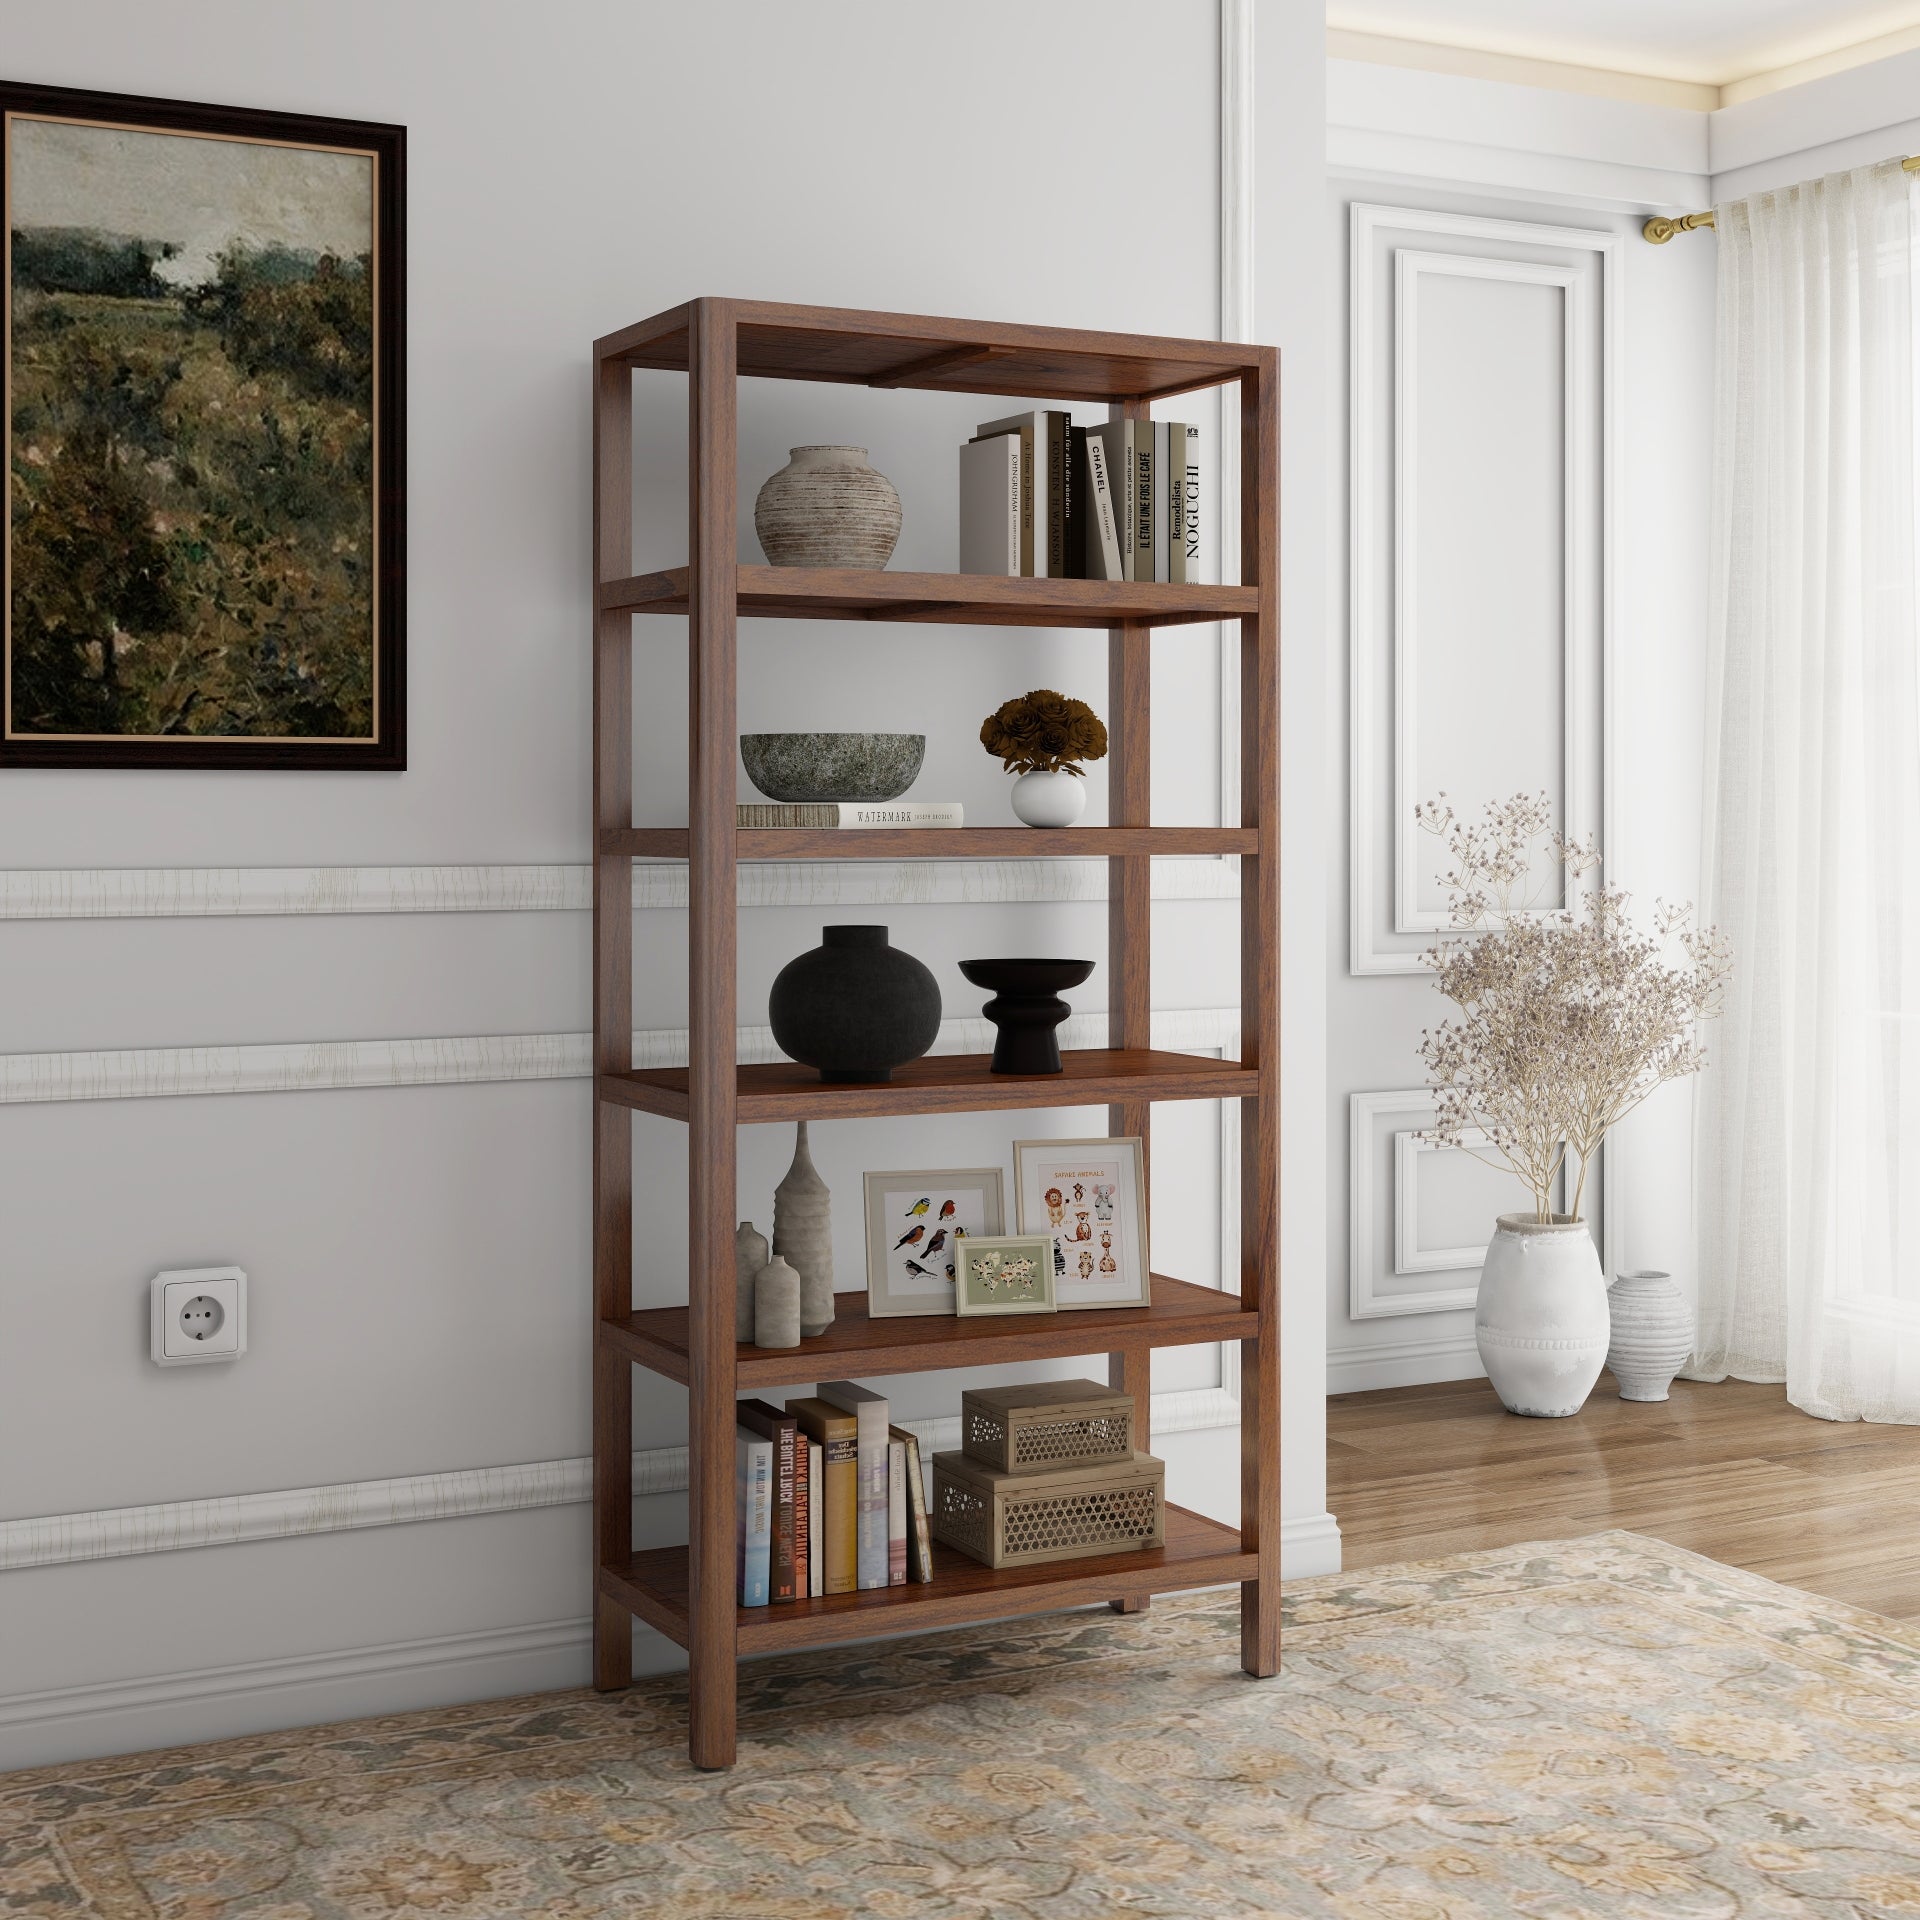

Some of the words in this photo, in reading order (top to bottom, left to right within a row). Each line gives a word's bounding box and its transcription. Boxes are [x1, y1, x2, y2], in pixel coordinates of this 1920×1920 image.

[1024, 441, 1032, 450] At
[1024, 453, 1032, 473] Home
[1052, 441, 1060, 491] KONSTEN
[1092, 446, 1105, 494] CHANEL
[1138, 452, 1151, 472] CAFÉ
[1140, 473, 1150, 482] LE
[1023, 485, 1032, 511] Joshua
[1140, 484, 1150, 501] FOIS
[1140, 502, 1150, 517] UNE
[1172, 480, 1181, 540] Remodelista
[1186, 465, 1199, 559] NOGUCHI
[1024, 513, 1032, 529] Tree
[1138, 519, 1150, 540] ÉTAIT
[1140, 541, 1150, 549] IL
[857, 811, 912, 822] WATERMARK
